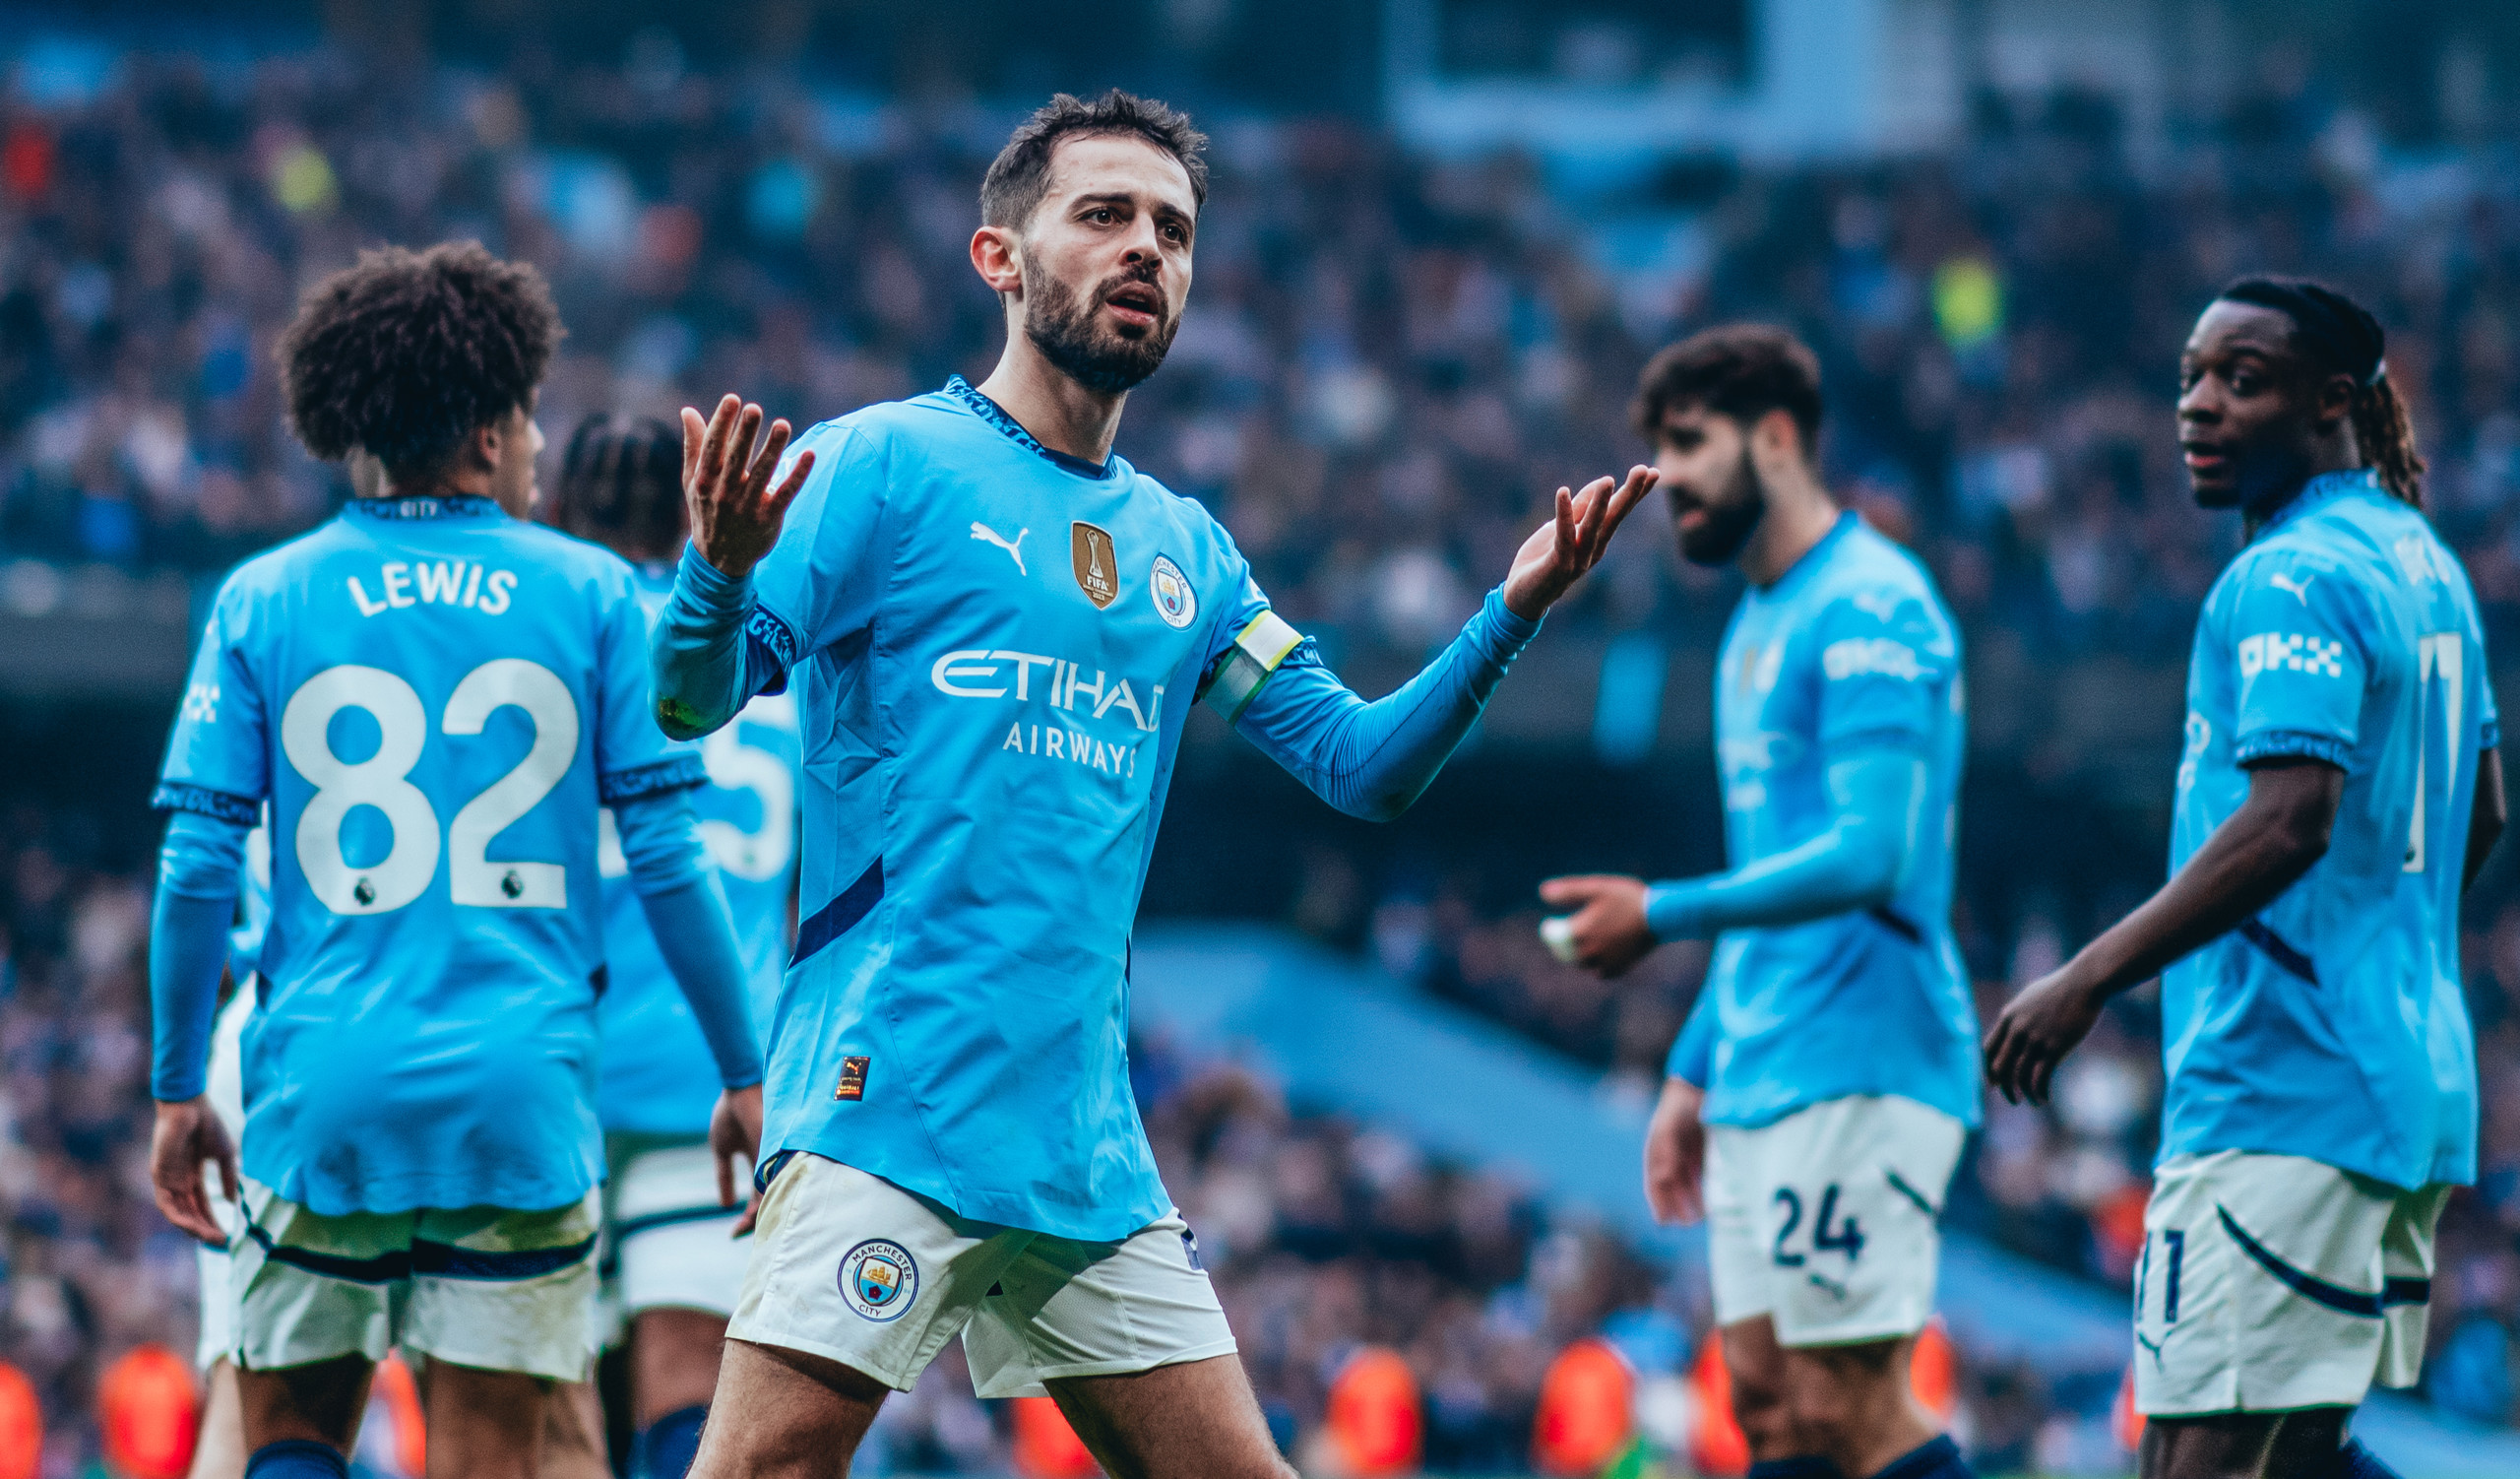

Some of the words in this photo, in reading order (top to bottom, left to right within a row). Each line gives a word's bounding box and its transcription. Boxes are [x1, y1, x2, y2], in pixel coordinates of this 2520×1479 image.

[400, 500, 438, 517] CITY
[346, 559, 519, 618] LEWIS
[1086, 574, 1108, 592] FIFA
[1002, 721, 1137, 779] AIRWAYS
[281, 658, 579, 917] 82
[1772, 1184, 1866, 1267] 24
[851, 1245, 913, 1281] MANCHESTER
[858, 1304, 881, 1318] CITY
